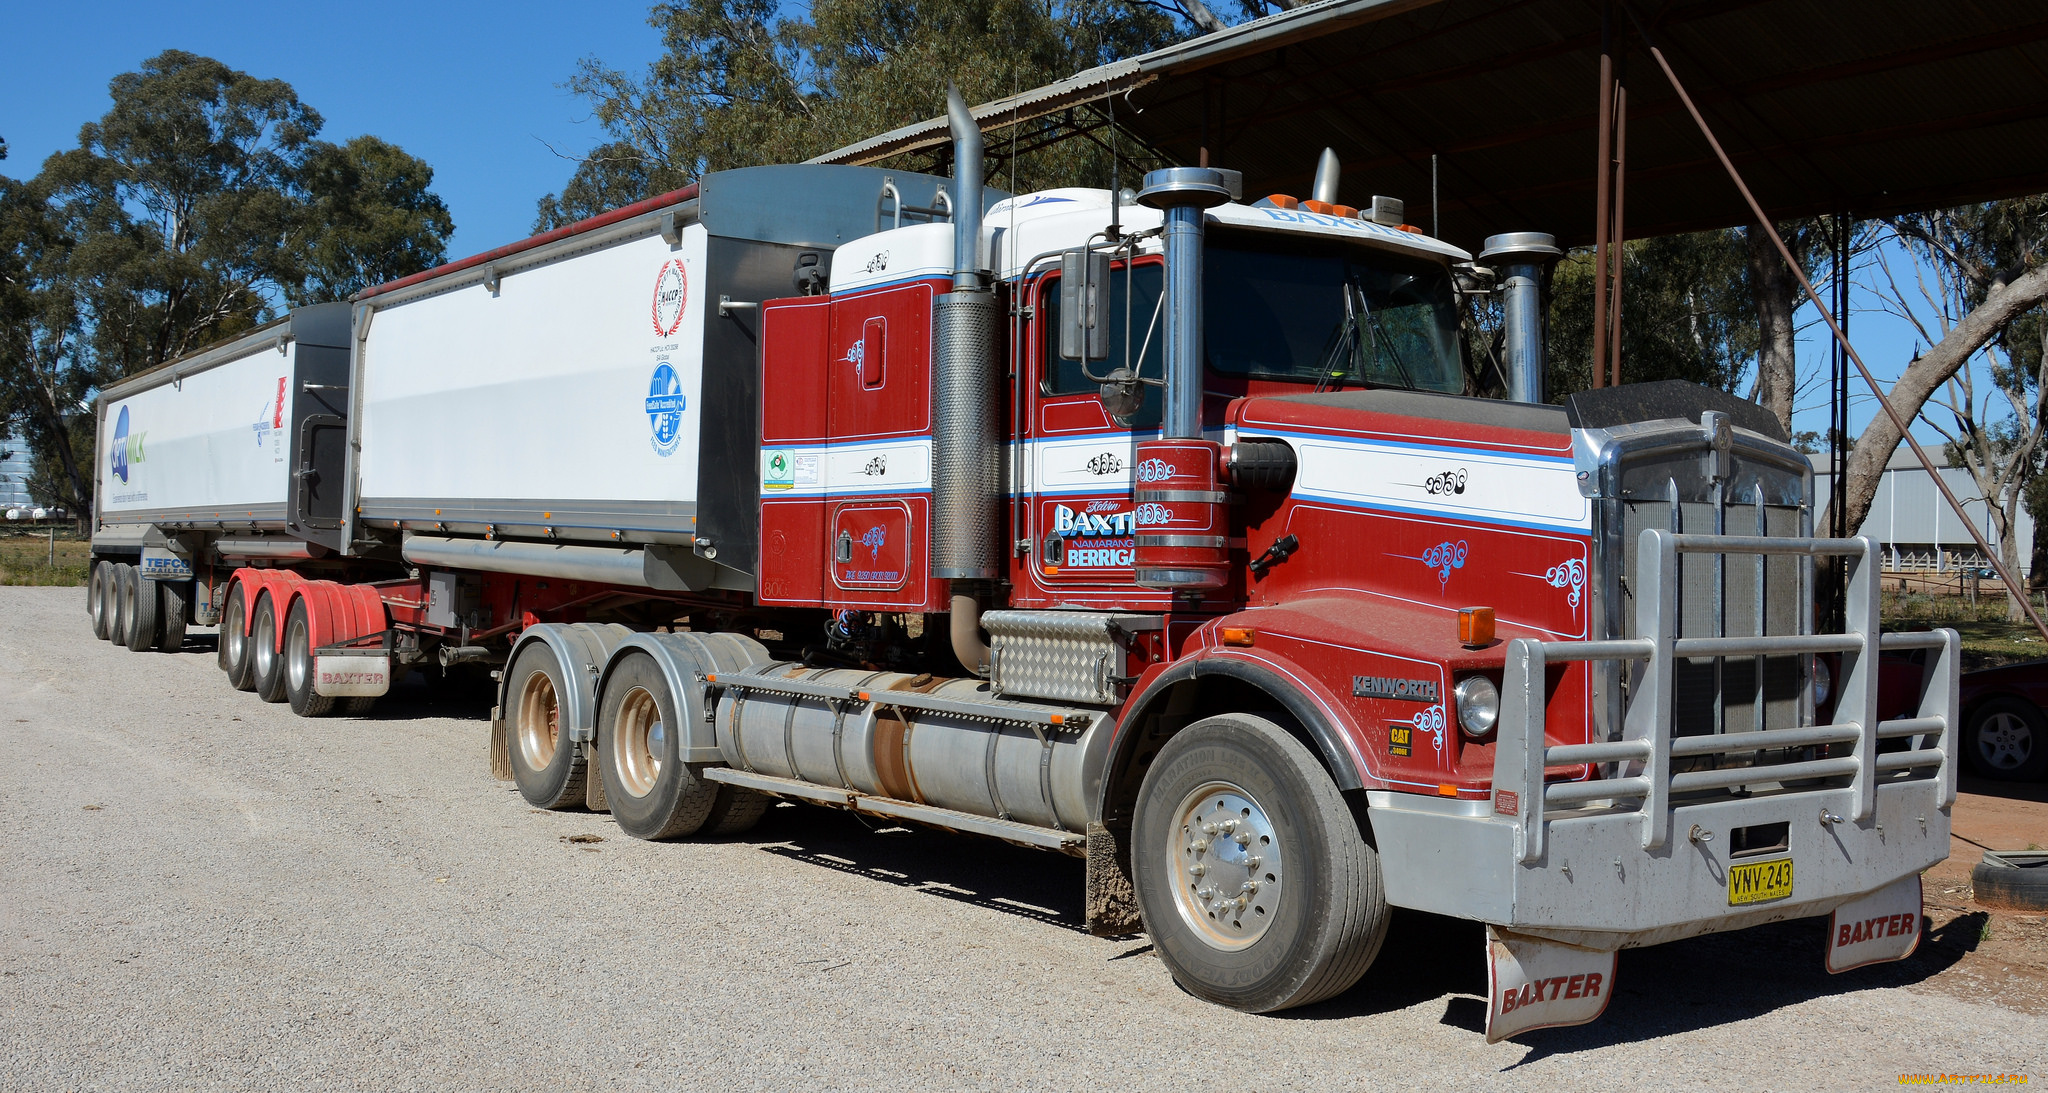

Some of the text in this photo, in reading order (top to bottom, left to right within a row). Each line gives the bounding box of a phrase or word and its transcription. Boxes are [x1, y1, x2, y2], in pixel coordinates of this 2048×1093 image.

[1264, 209, 1438, 246] BAXTER
[661, 289, 678, 306] HACCP
[146, 557, 191, 568] TEFCO
[322, 672, 384, 685] BAXTER
[1353, 675, 1438, 697] KENWORTH
[1391, 728, 1410, 745] CAT
[1737, 895, 1748, 903] NEW
[1750, 892, 1767, 901] SOUTH
[1837, 913, 1915, 948] BAXTER
[1500, 972, 1603, 1016] BAXTER
